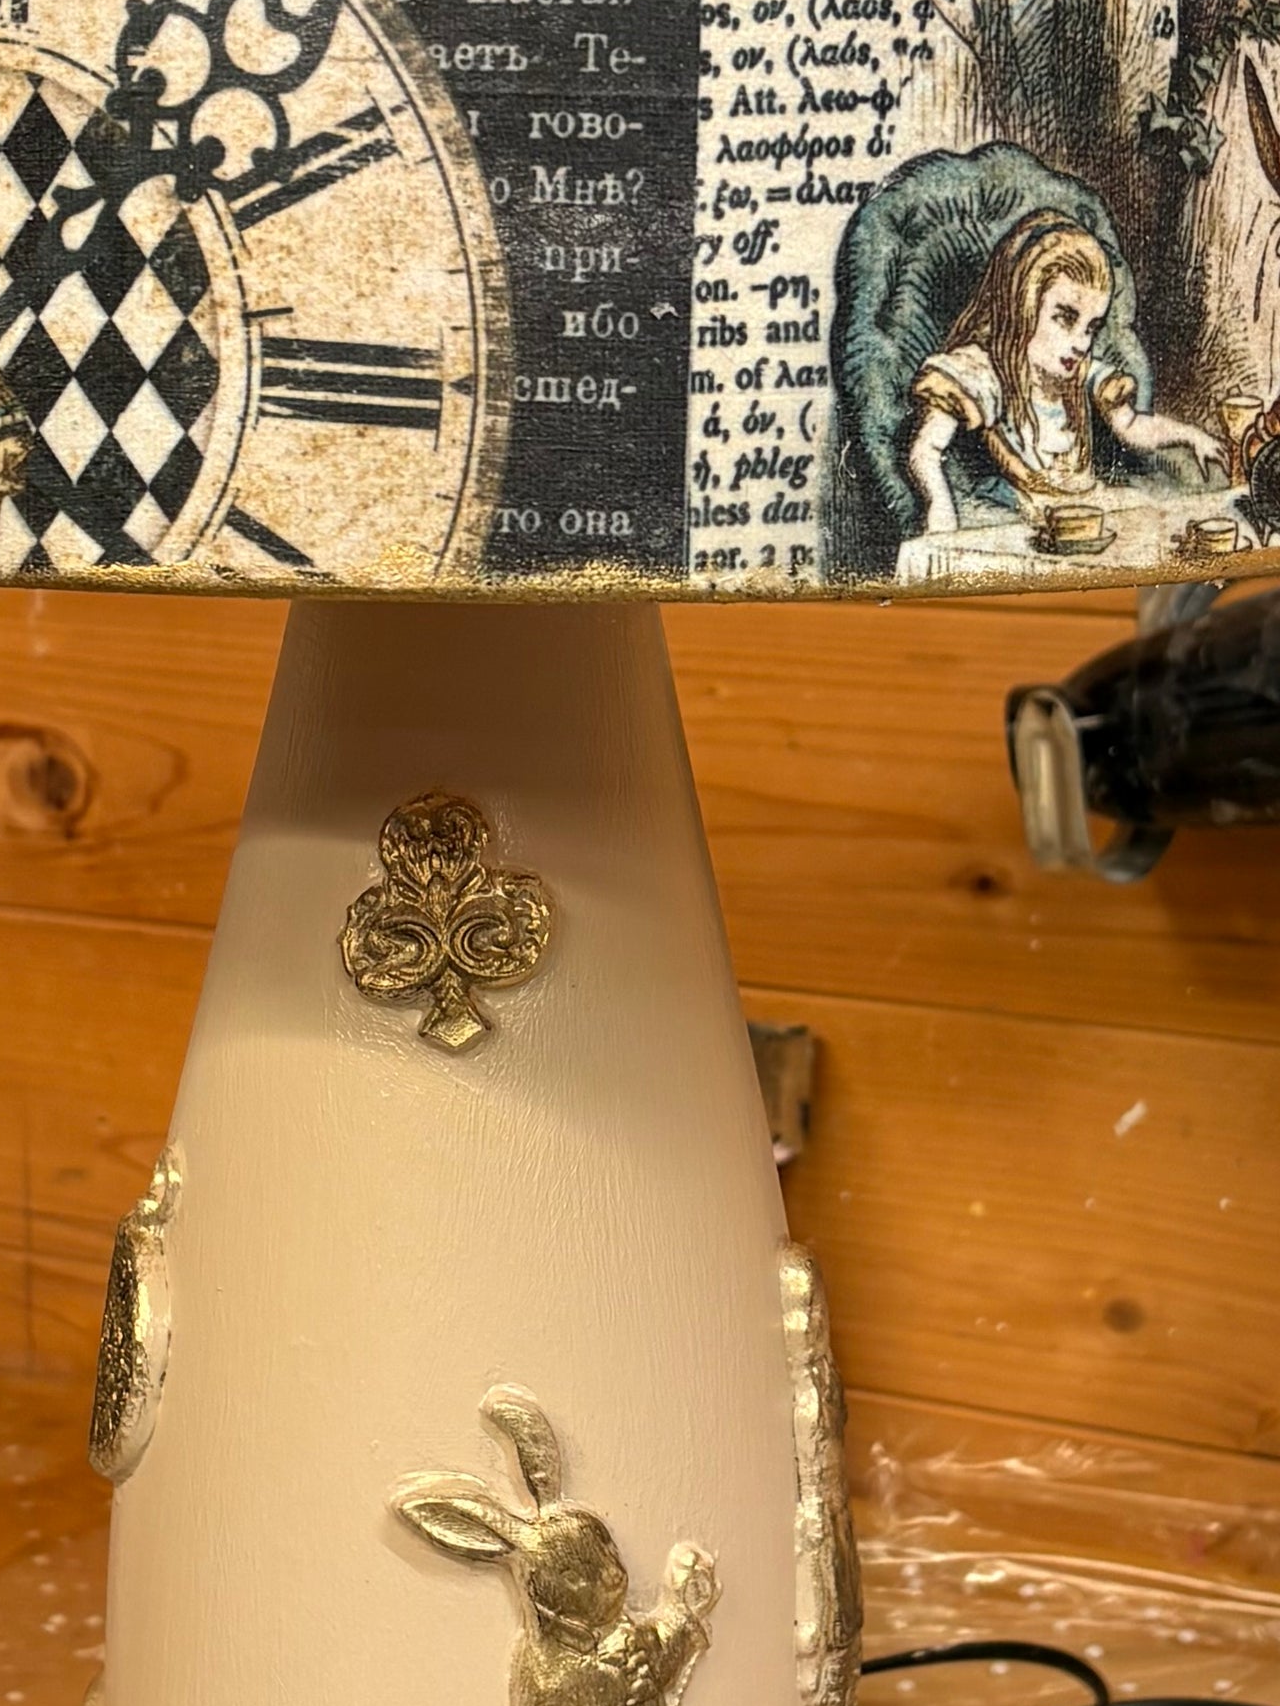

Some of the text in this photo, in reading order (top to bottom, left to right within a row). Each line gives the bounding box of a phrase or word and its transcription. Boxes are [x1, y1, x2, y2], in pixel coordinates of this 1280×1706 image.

[543, 244, 640, 283] при-
[562, 302, 639, 339] ибо
[696, 309, 822, 349] ribs and
[734, 357, 771, 391] of
[559, 508, 634, 536] она
